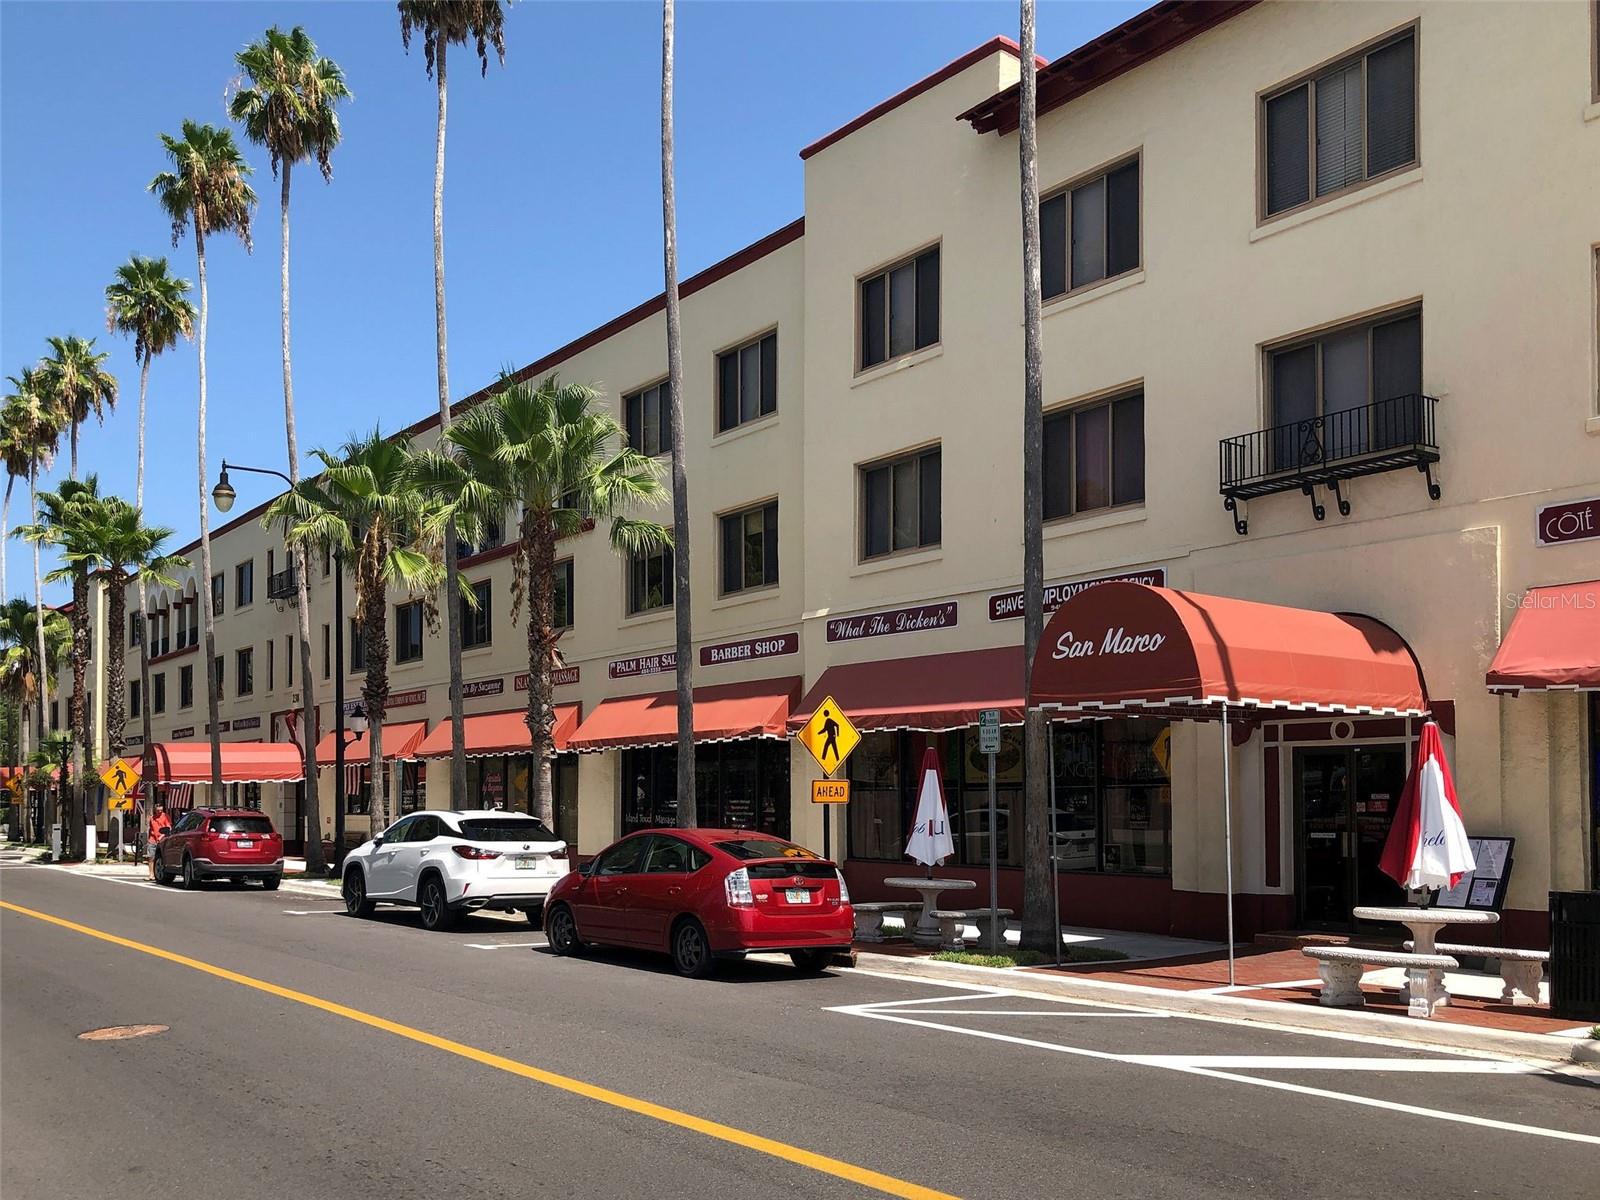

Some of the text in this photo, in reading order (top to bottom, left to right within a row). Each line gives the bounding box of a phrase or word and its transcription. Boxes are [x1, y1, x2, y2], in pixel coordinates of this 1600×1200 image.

[1546, 506, 1593, 540] CÔTÉ
[869, 616, 891, 635] The
[711, 639, 786, 662] BARBER SHOP
[1052, 627, 1166, 660] San Marco
[616, 660, 637, 673] PALM
[640, 657, 660, 670] HAIR
[661, 654, 677, 666] SAL
[816, 786, 845, 797] AHEAD
